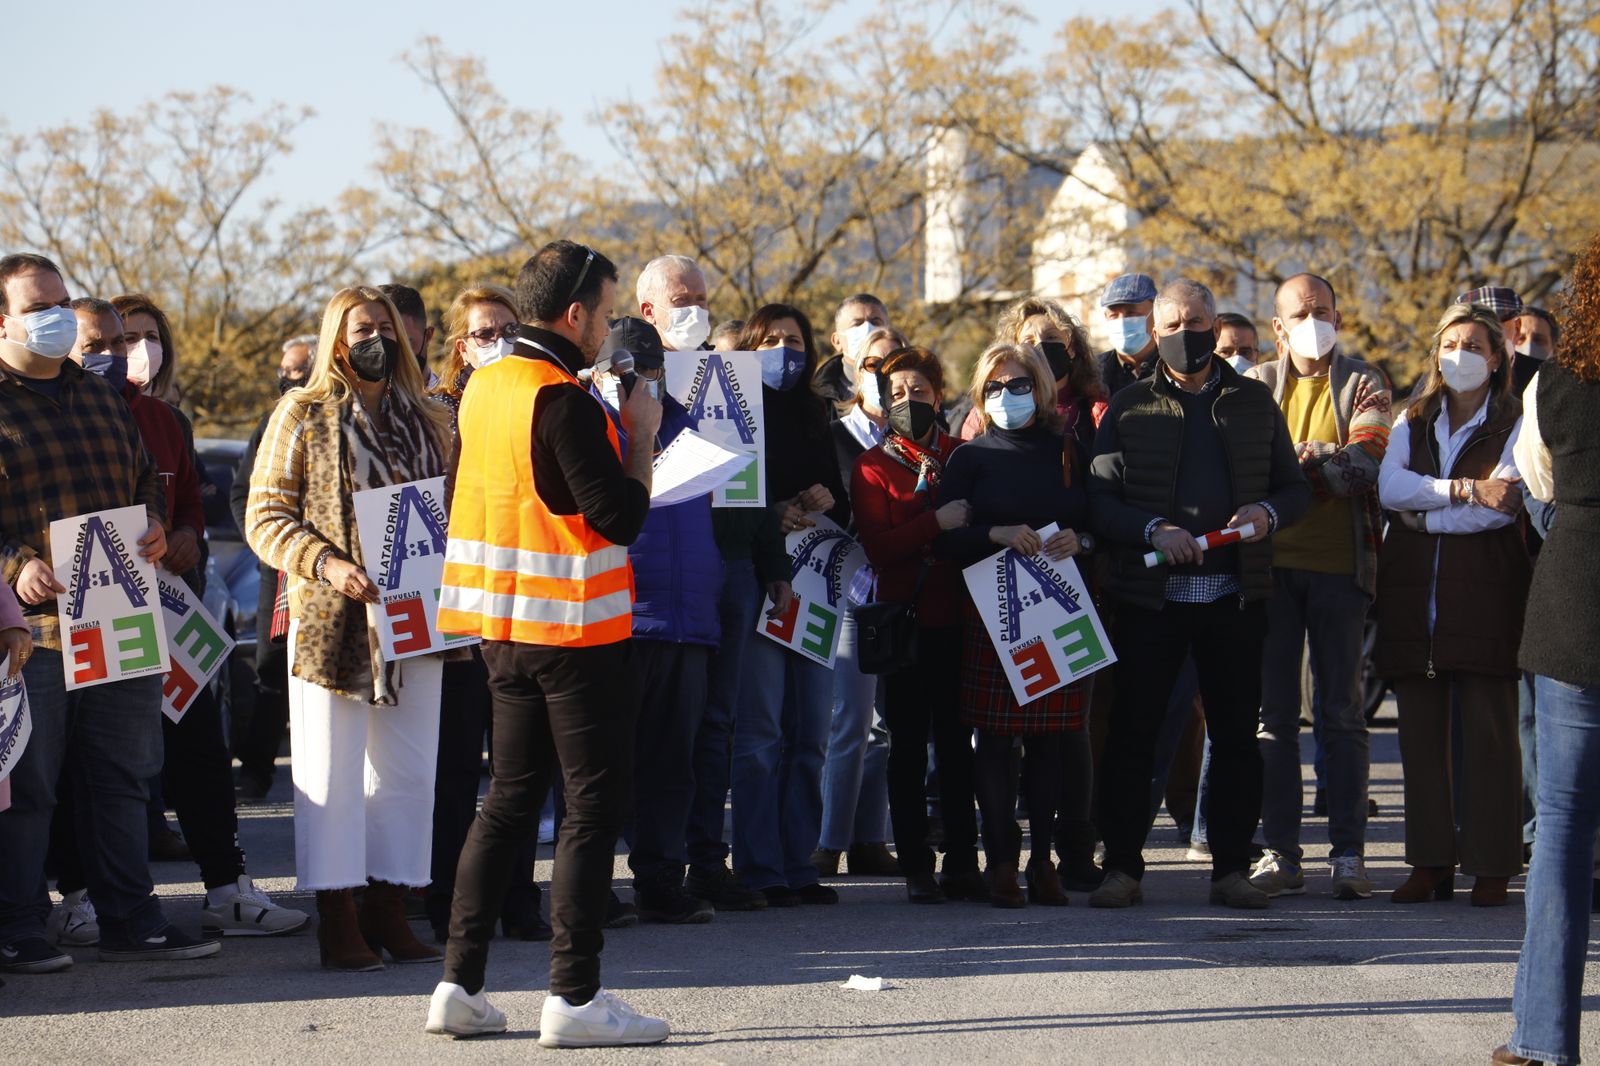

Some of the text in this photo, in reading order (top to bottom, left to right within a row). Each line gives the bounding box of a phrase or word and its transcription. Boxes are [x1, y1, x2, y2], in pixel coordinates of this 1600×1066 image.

[684, 358, 708, 411] AFORMA
[724, 361, 758, 434] CIUDADANA
[422, 490, 449, 534] CIUDA
[105, 521, 150, 597] CIUDADANA
[378, 492, 402, 587] PLATAFORMA
[65, 522, 88, 616] PLATAFORMA
[158, 580, 185, 602] DANA
[1031, 554, 1081, 602] UDADANA
[383, 590, 421, 602] REVUELTA
[996, 555, 1009, 642] PLATAFORMA
[69, 620, 100, 631] REVUELTA
[1009, 635, 1041, 655] REVUELTA
